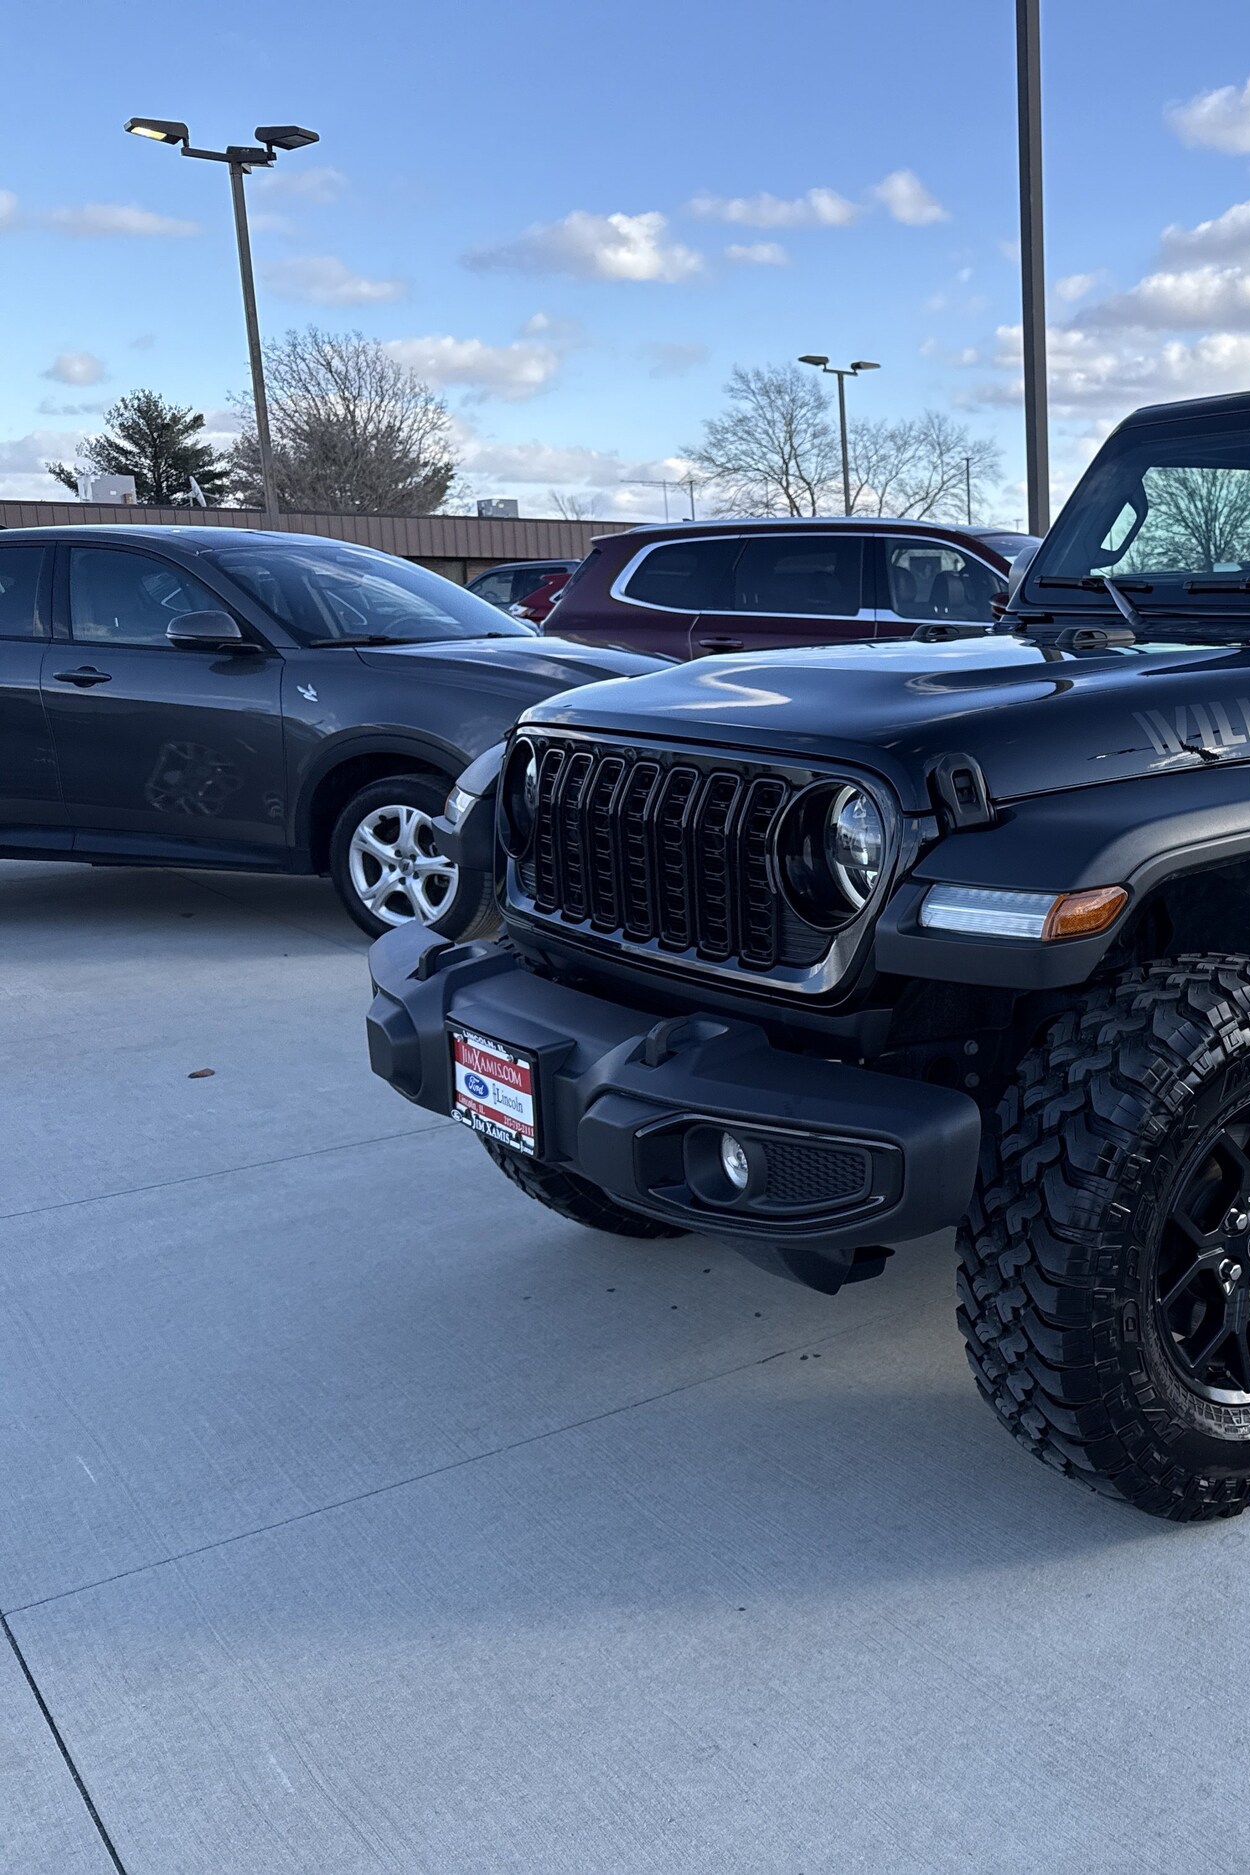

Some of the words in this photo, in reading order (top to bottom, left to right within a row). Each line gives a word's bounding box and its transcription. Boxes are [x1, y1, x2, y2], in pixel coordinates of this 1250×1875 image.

[496, 1087, 523, 1113] Lincoln
[472, 1114, 486, 1133] JIM
[485, 1121, 511, 1144] XAMIS
